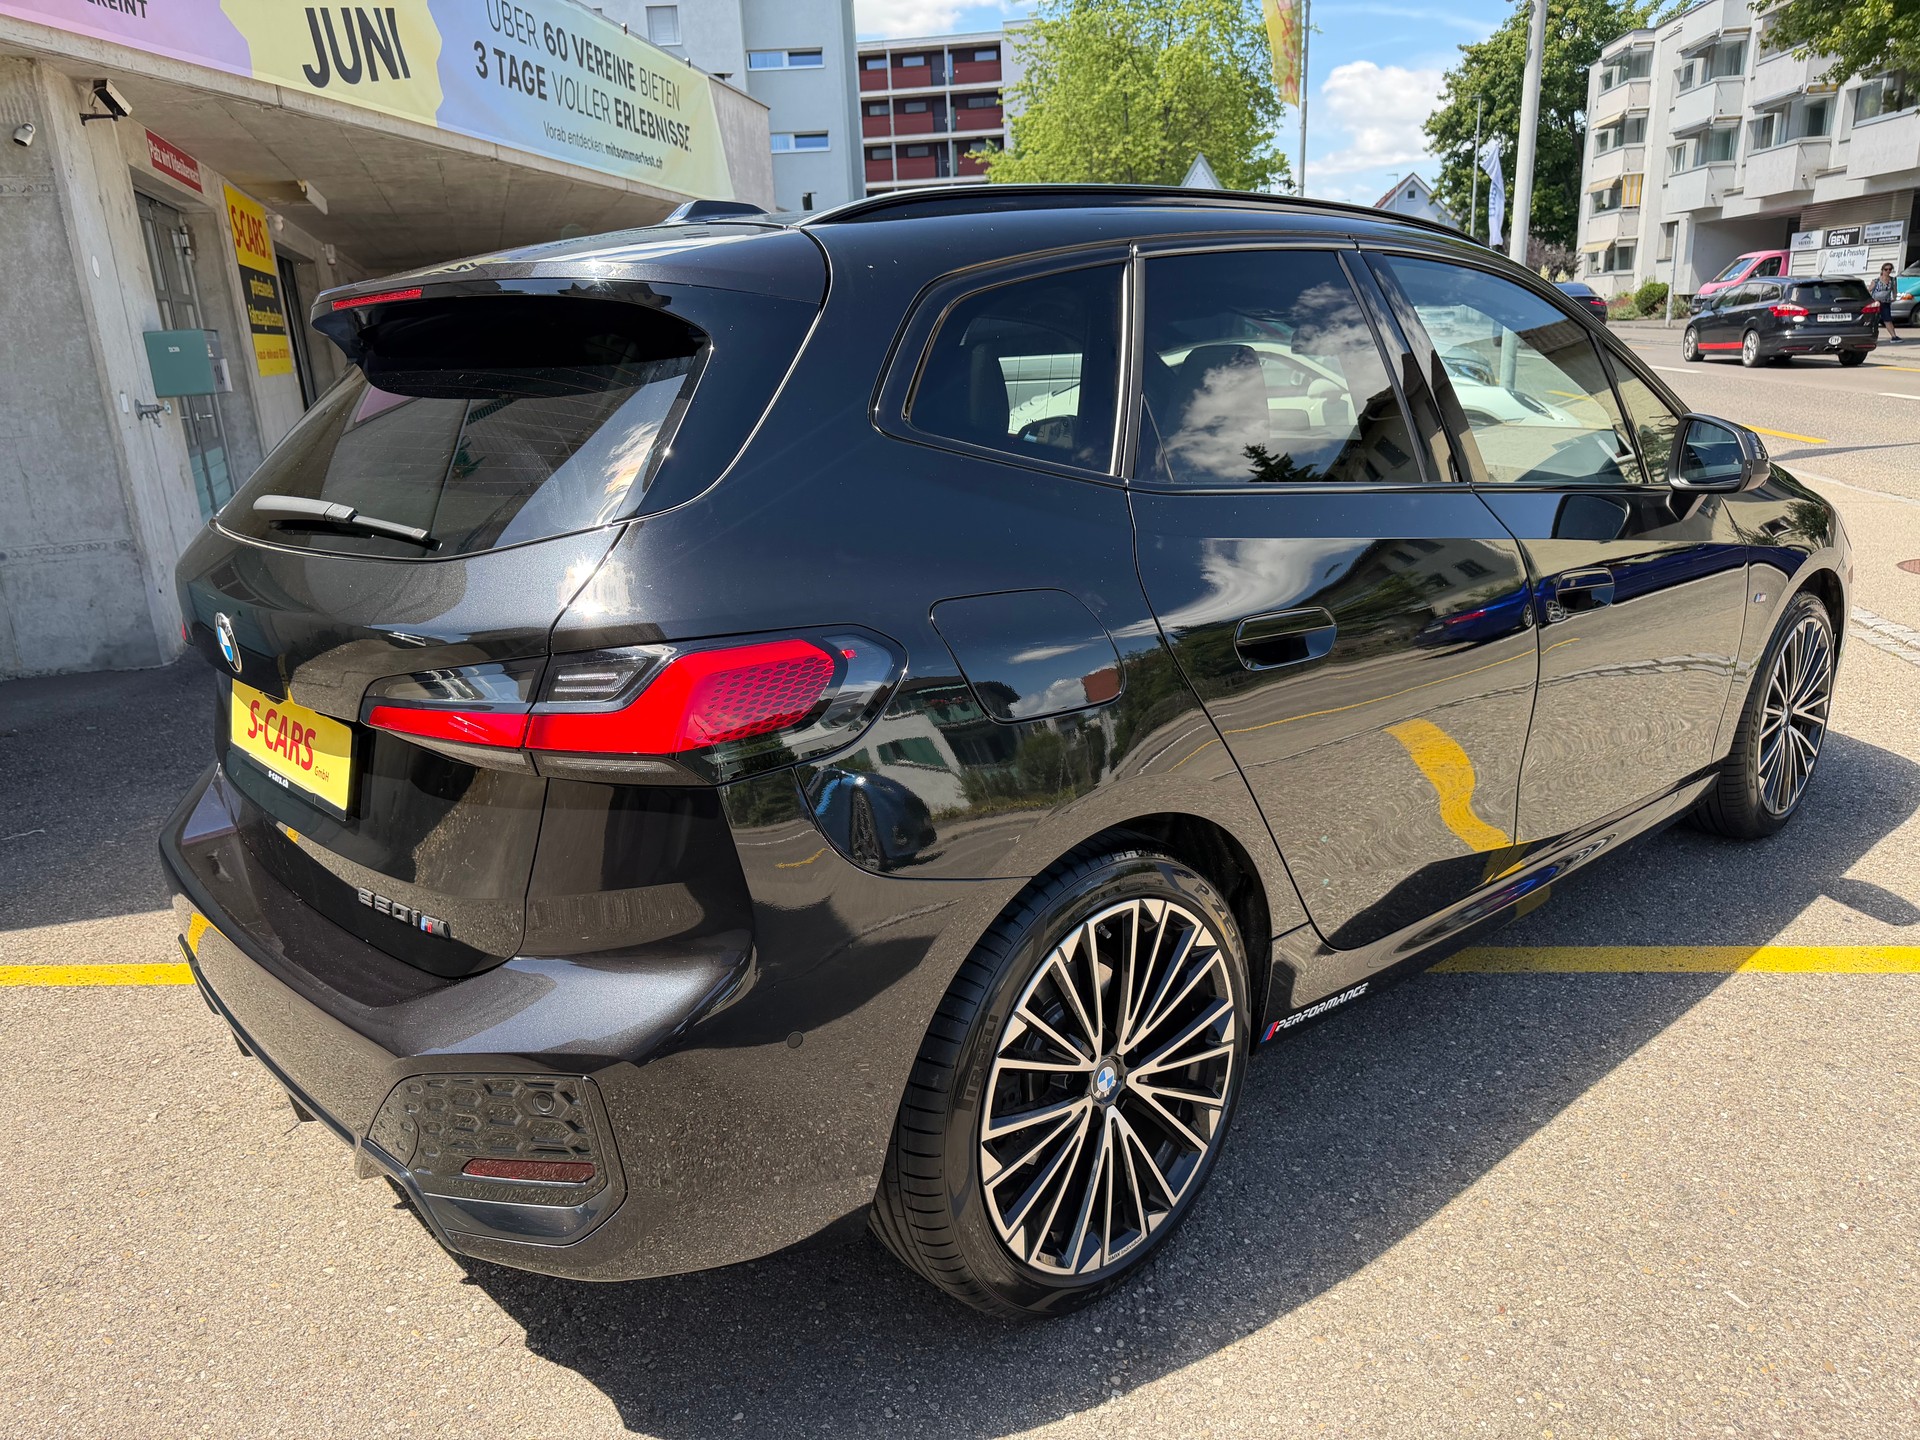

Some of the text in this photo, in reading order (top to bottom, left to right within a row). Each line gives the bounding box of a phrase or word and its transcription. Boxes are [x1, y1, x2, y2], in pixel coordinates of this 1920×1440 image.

[302, 7, 411, 88] JUNI
[543, 21, 568, 62] 60
[571, 33, 637, 92] VEREINE
[639, 66, 681, 111] BIETEN
[474, 40, 693, 152] 3 TAGE VOLLER ERLEBNISSE.
[543, 120, 566, 142] Vorab
[605, 142, 663, 169] mitsommerfest.ch
[231, 204, 267, 258] S-CARS
[1830, 234, 1850, 246] BENI
[247, 699, 317, 771] S-CARS
[314, 765, 330, 783] GmbH
[1275, 982, 1370, 1033] PERFORMANCE
